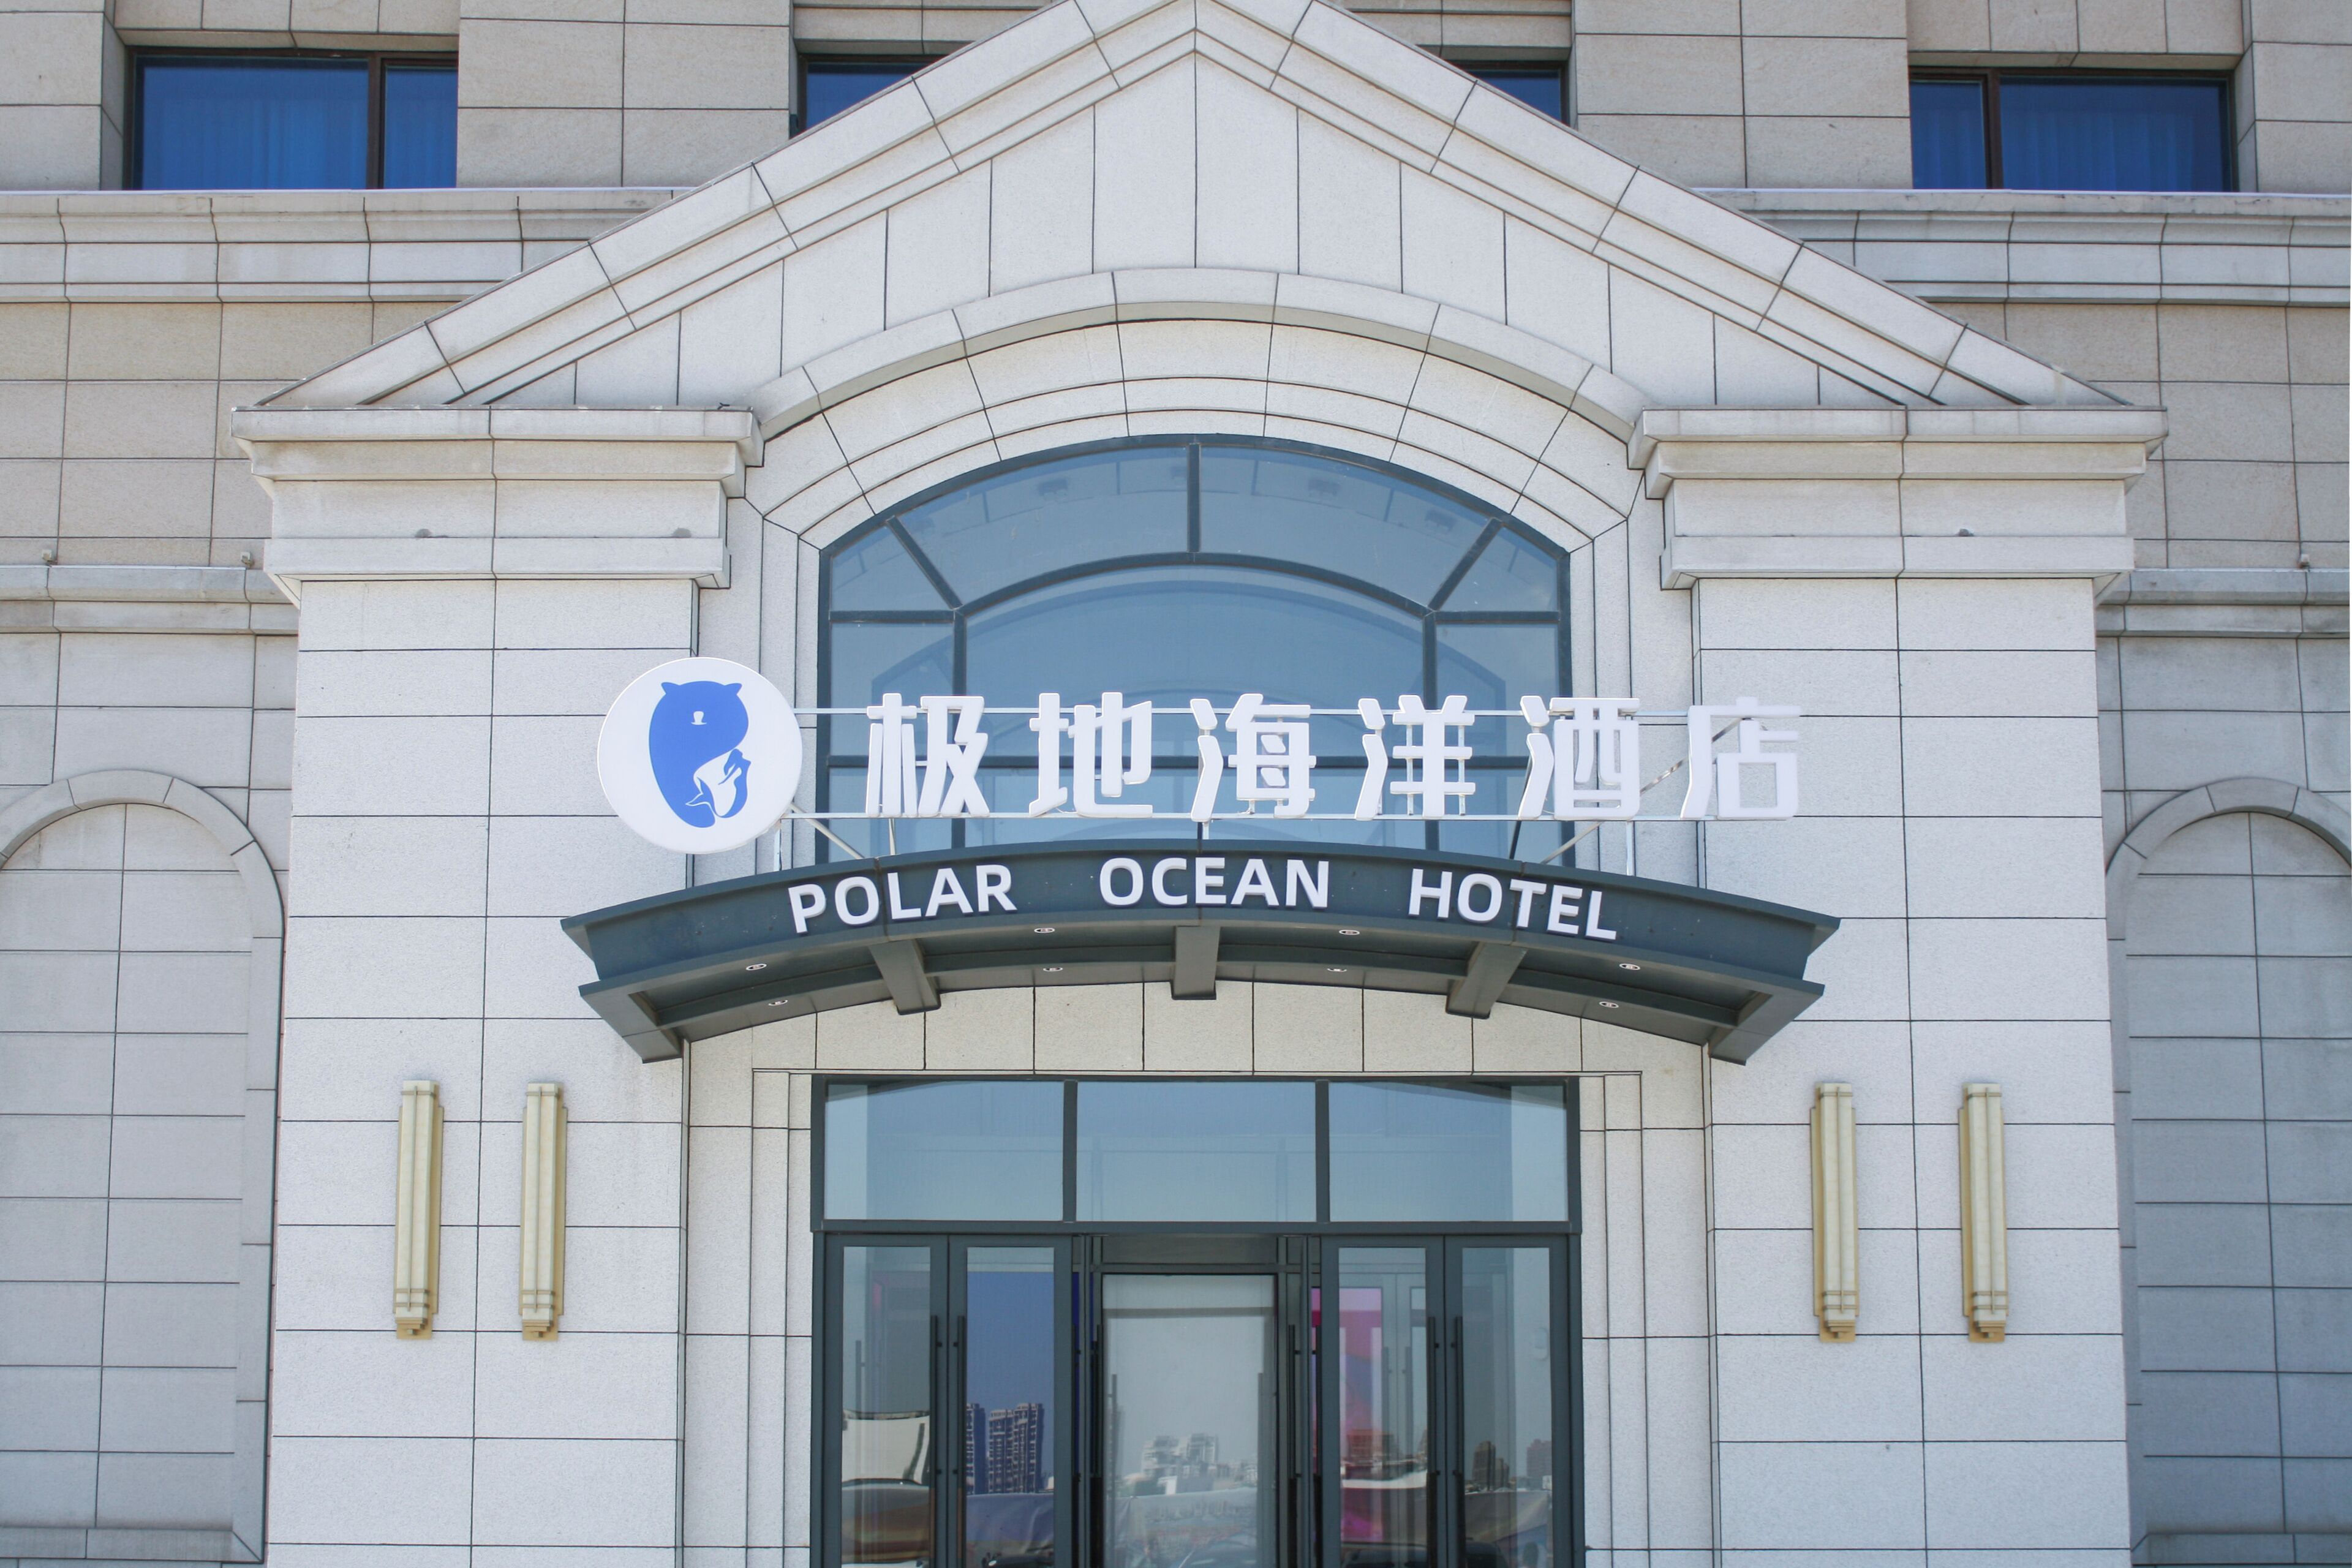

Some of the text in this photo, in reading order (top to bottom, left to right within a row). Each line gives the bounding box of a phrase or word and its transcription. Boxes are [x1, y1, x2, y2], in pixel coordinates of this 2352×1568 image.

[864, 692, 1800, 822] 极地海洋酒店
[788, 856, 1618, 941] POLAR OCEAN HOTEL
